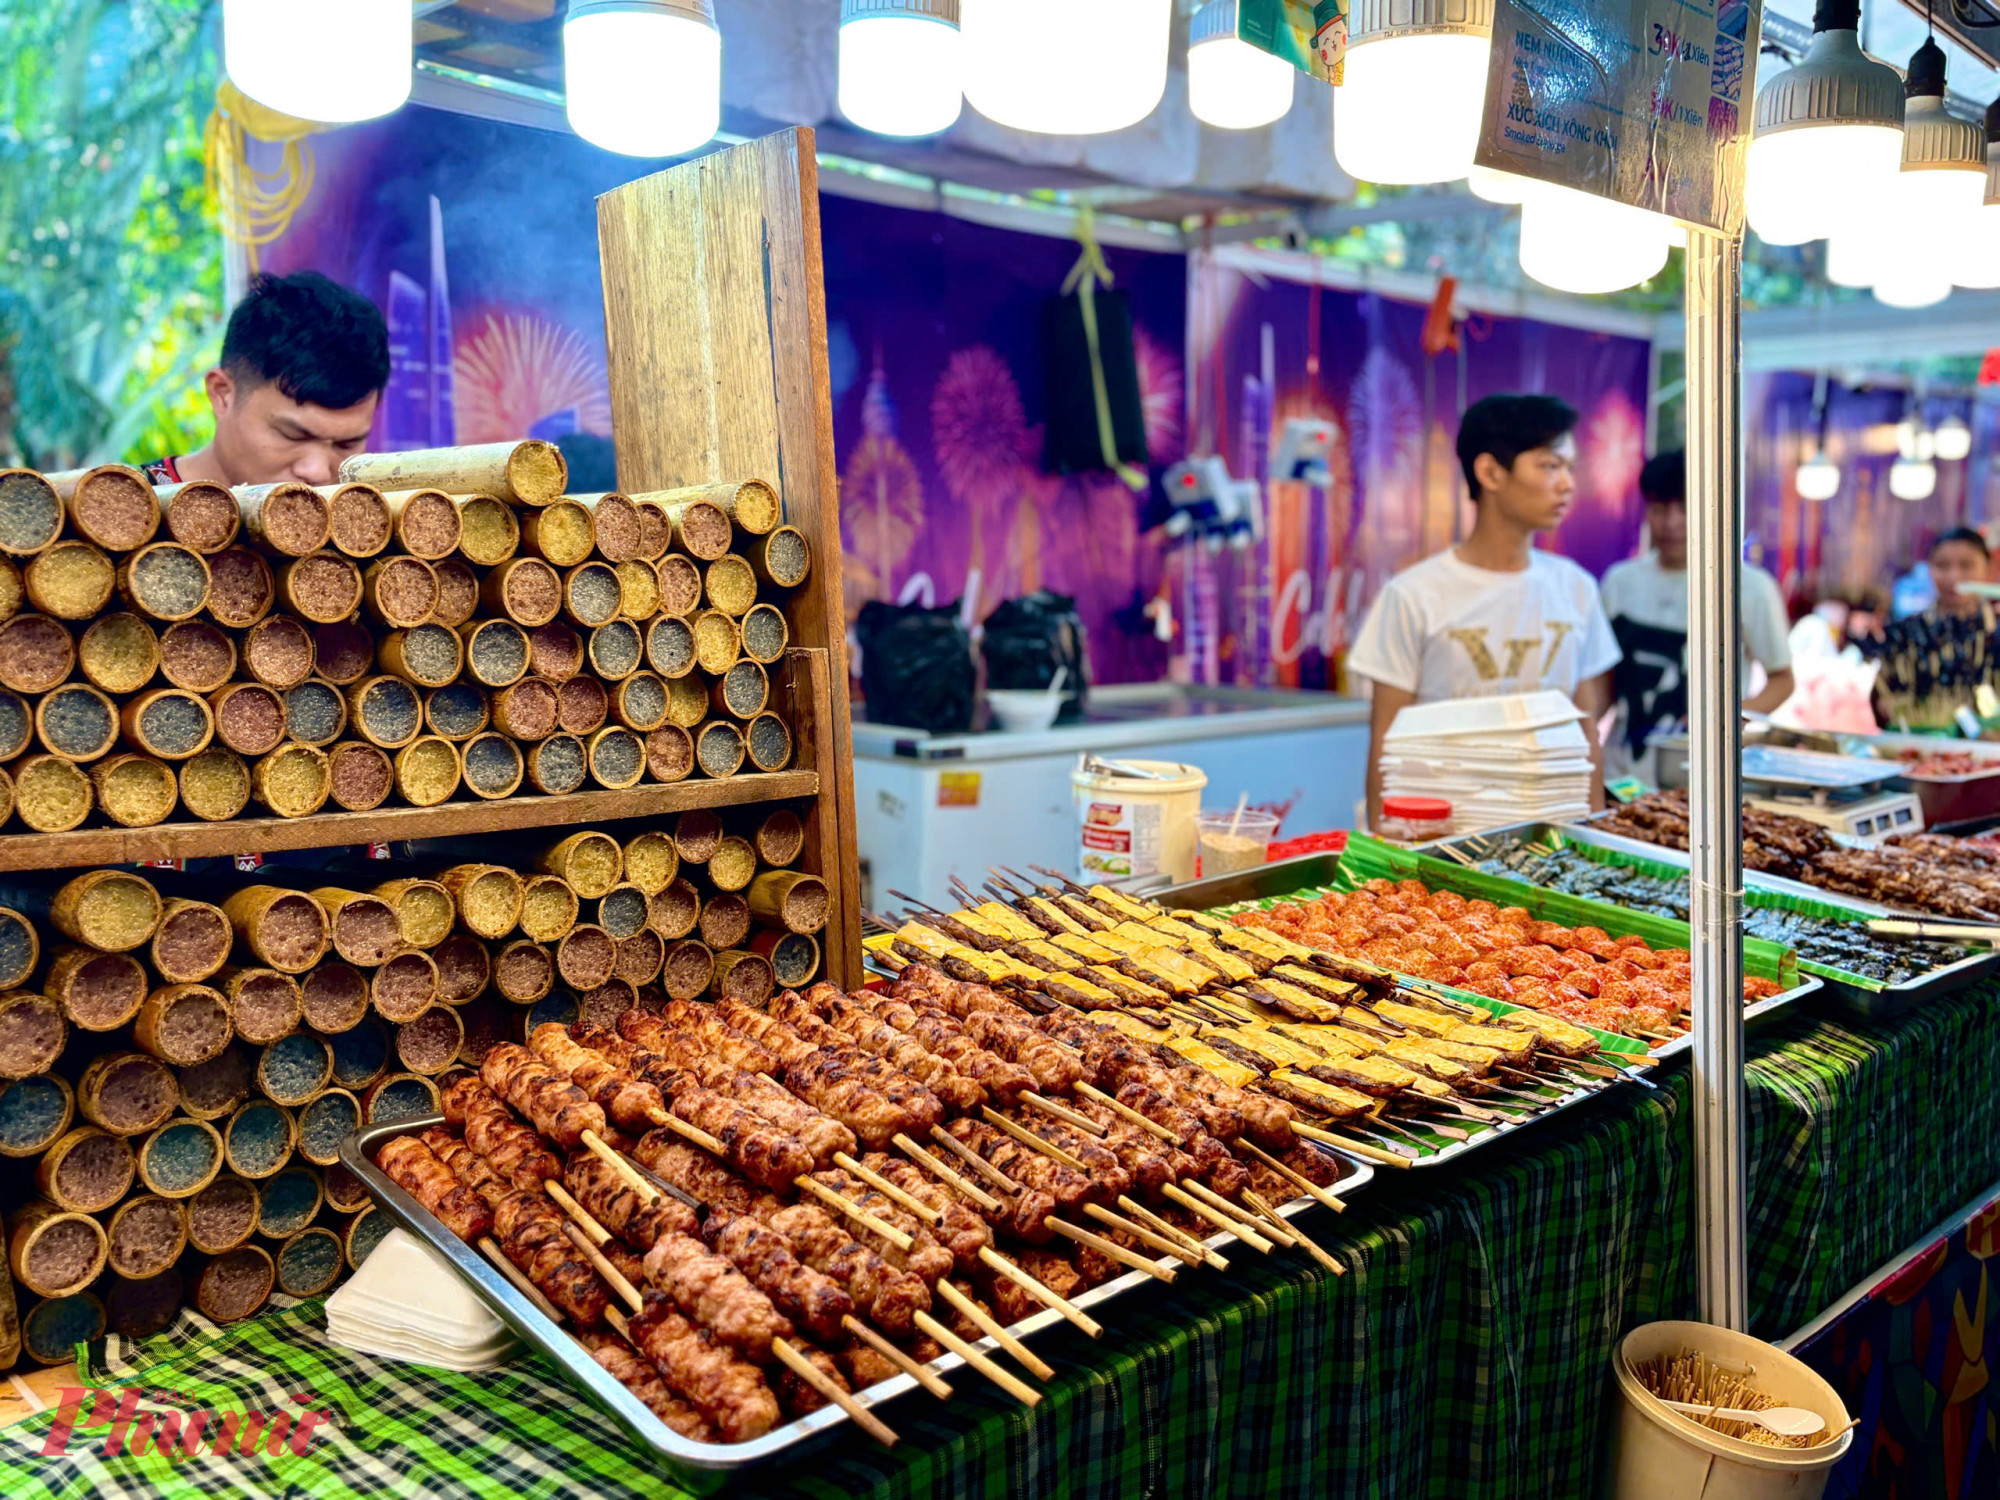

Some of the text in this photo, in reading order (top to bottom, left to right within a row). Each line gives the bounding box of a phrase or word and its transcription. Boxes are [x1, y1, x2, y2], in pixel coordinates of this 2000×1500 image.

[1515, 29, 1540, 54] NEM
[1506, 99, 1533, 124] XÚC
[1562, 118, 1592, 143] XÔNG
[1504, 126, 1536, 144] Smoked
